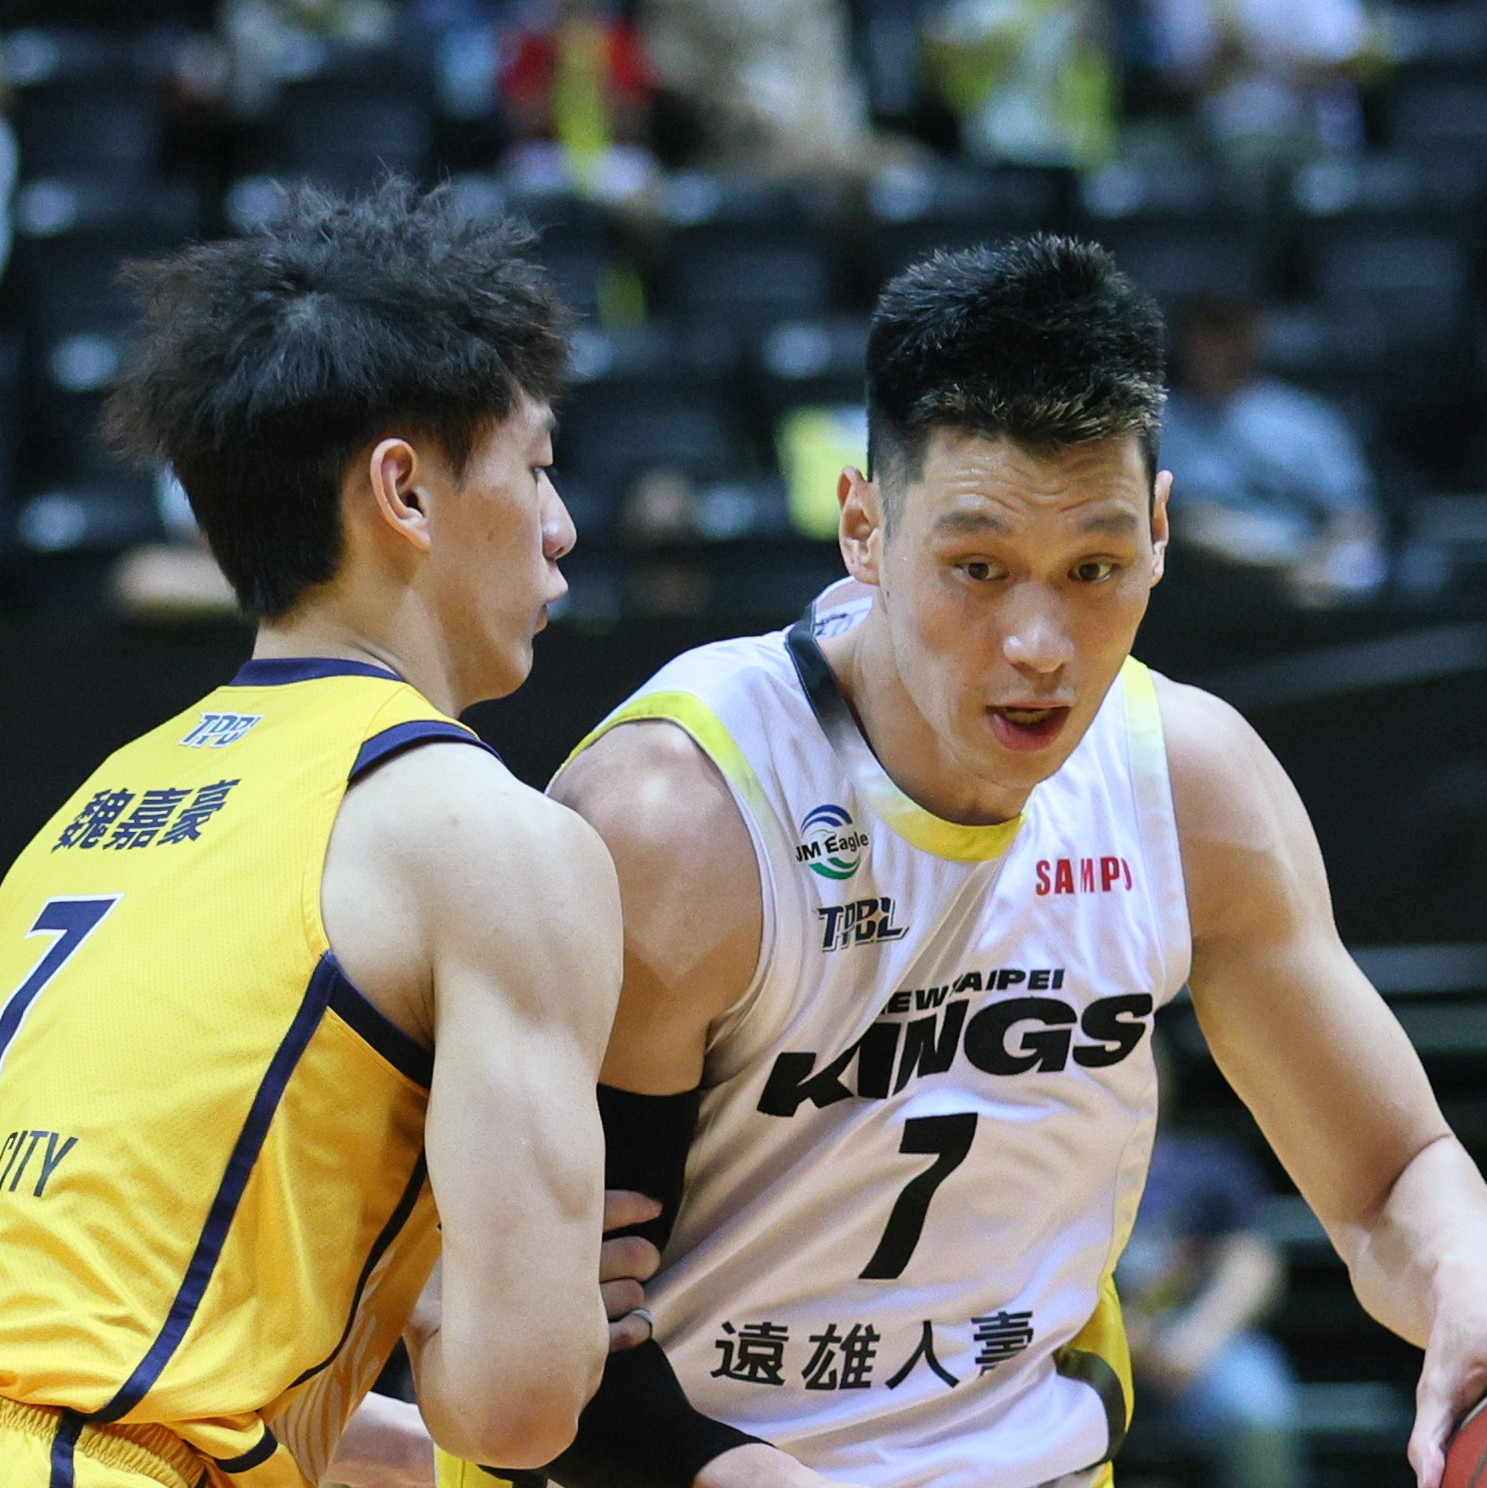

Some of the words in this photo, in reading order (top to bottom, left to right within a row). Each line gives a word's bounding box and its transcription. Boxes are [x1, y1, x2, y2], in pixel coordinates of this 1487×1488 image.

[178, 712, 264, 748] TPB
[50, 778, 242, 853] 魏嘉豪
[824, 832, 869, 853] Eagle
[815, 897, 910, 952] TPBL
[881, 986, 949, 1015] EW
[949, 968, 1065, 996] AIPEI
[756, 993, 1154, 1118] KINGS
[858, 1112, 979, 1280] 7
[710, 1311, 1034, 1391] 遠雄人壽
